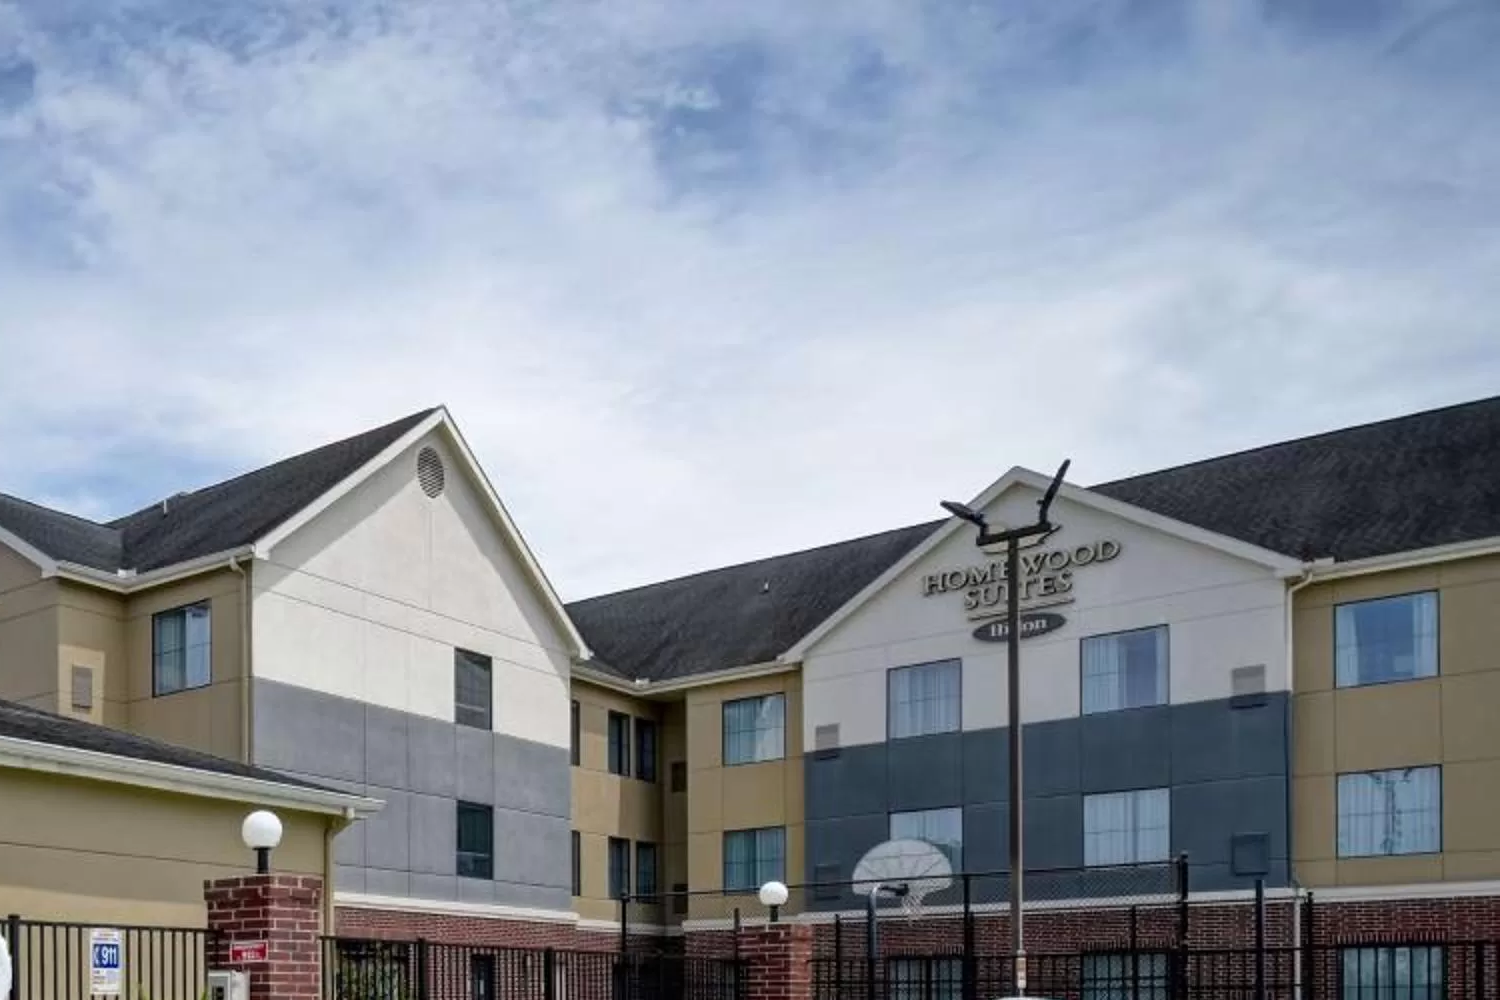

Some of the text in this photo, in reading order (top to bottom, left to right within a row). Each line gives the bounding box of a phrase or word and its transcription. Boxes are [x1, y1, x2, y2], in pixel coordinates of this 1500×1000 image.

[922, 539, 1121, 597] HOMEWOOD
[990, 618, 1048, 637] Hion
[101, 945, 117, 965] 911
